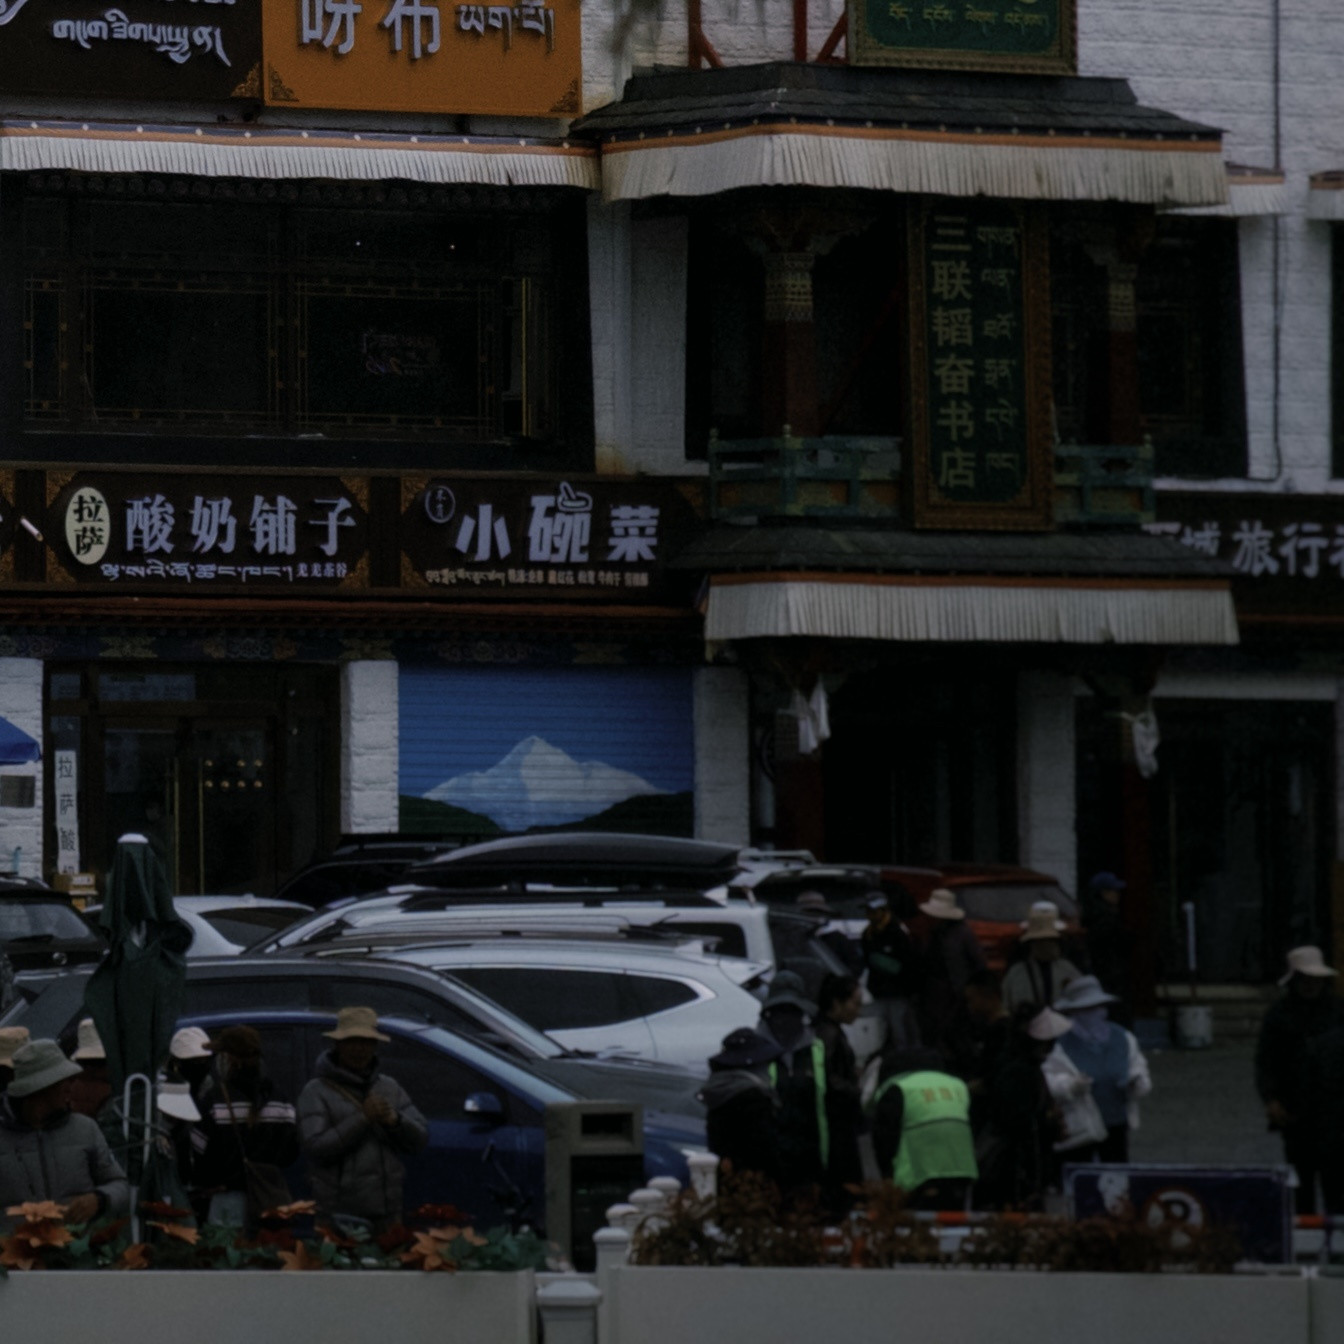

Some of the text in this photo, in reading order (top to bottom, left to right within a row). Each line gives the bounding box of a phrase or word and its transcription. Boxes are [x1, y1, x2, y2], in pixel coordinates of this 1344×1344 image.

[931, 216, 977, 490] 三联韬奋书店
[73, 494, 104, 556] 拉萨
[127, 494, 355, 558] 酸奶铺子
[451, 482, 659, 562] 小碗菜
[1140, 518, 1344, 580] 城旅行
